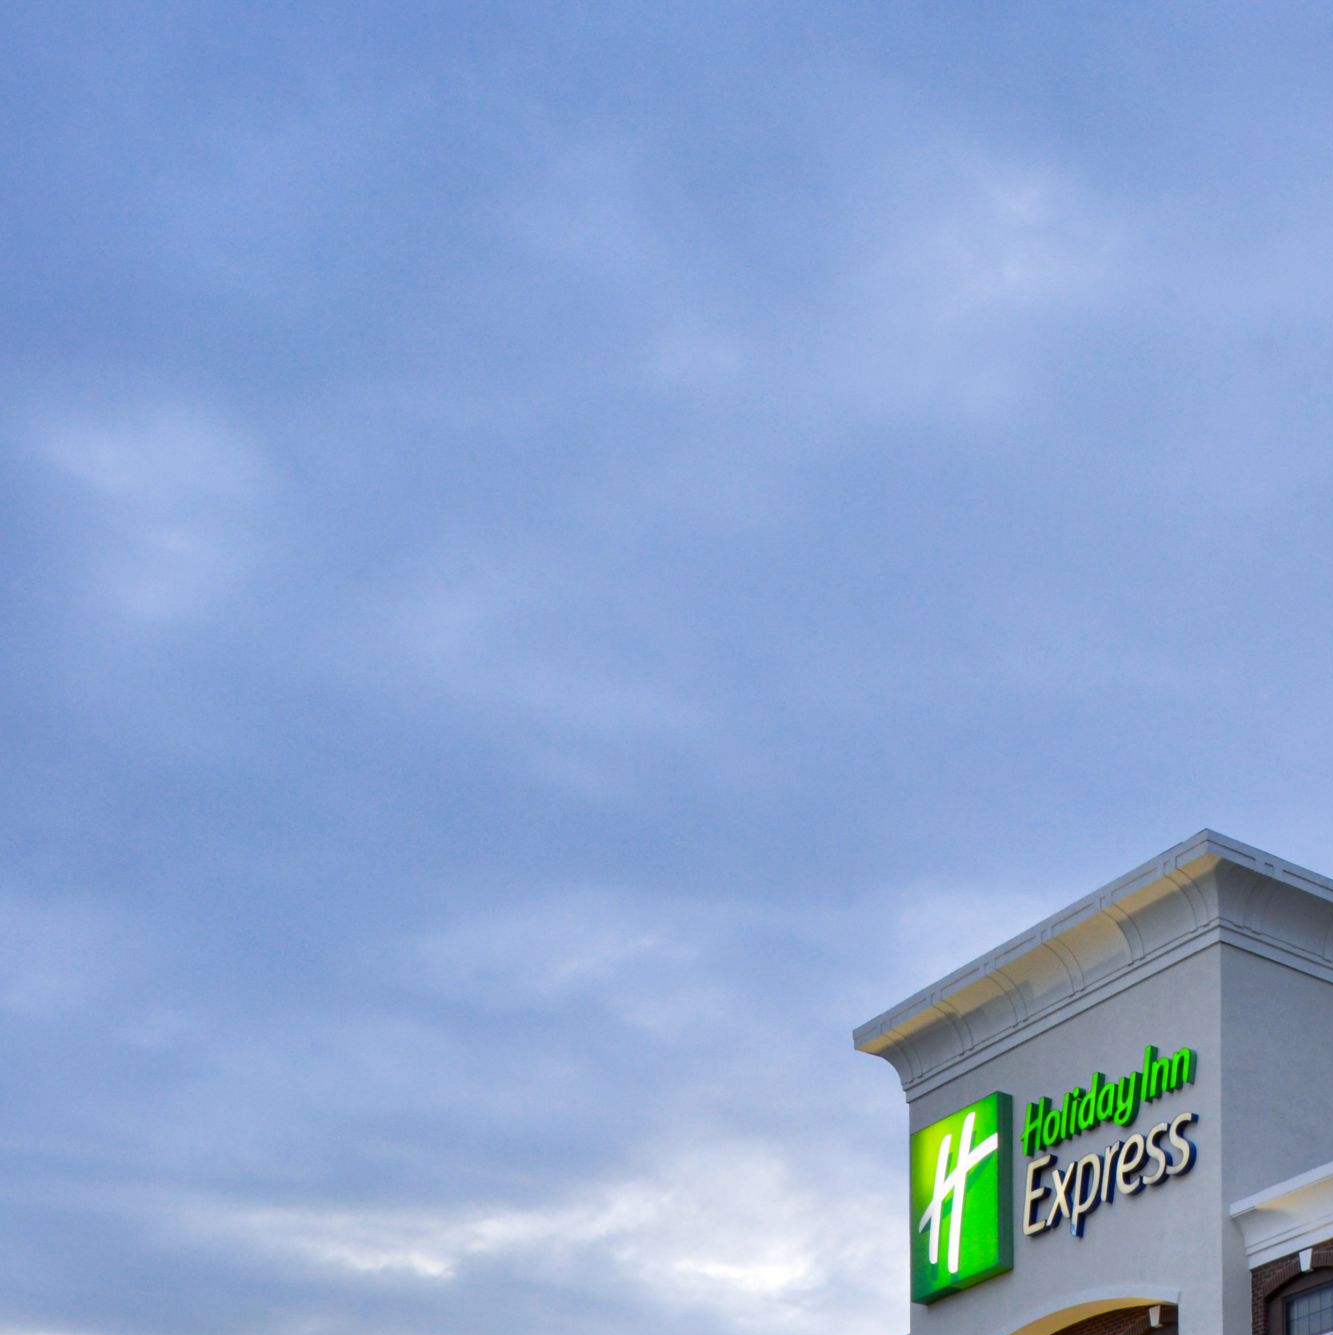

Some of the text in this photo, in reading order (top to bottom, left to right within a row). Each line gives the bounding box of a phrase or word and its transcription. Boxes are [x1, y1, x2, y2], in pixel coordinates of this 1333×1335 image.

[1021, 1045, 1195, 1156] Holiday Inn
[1023, 1112, 1198, 1237] Express
